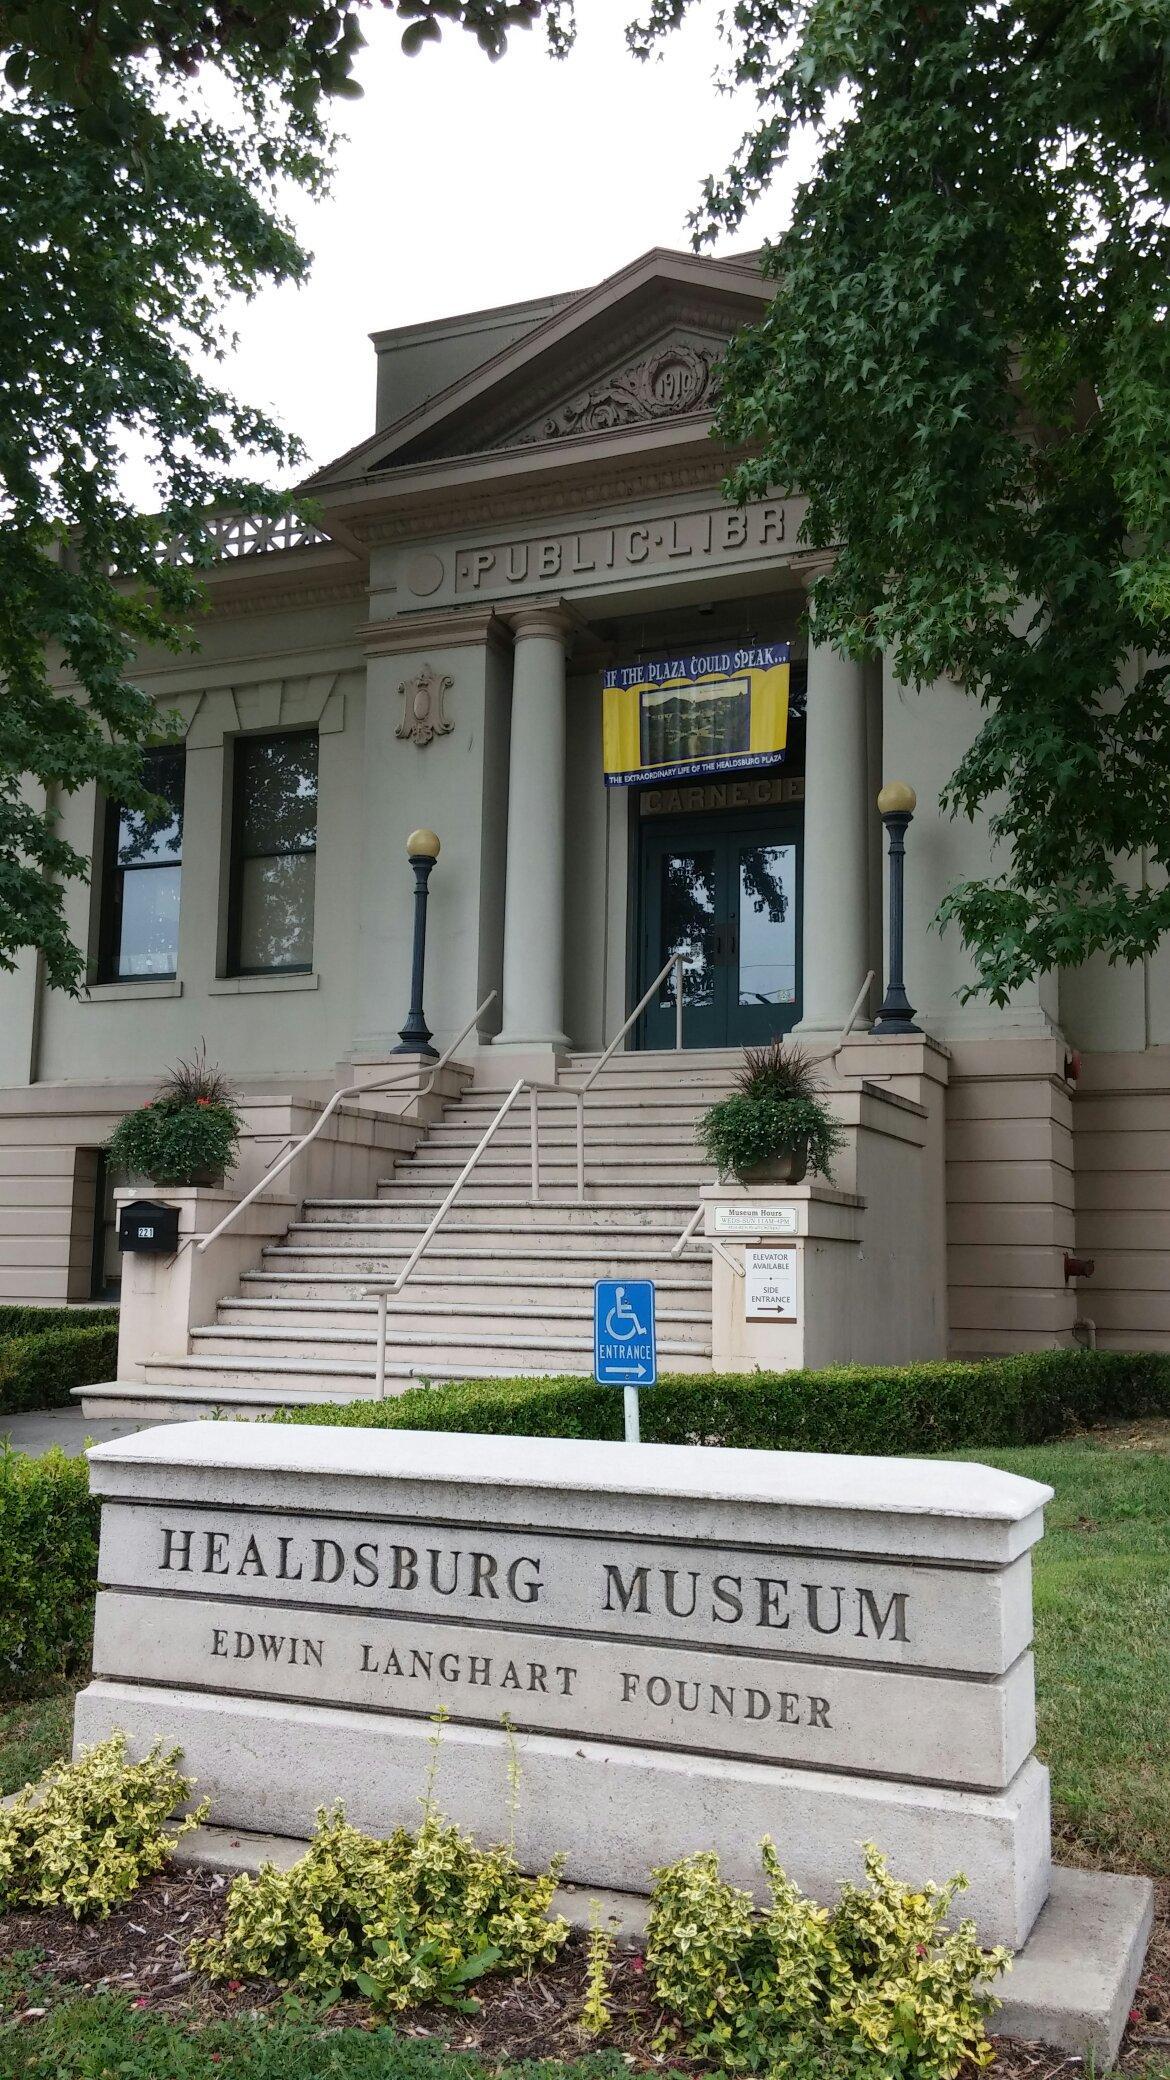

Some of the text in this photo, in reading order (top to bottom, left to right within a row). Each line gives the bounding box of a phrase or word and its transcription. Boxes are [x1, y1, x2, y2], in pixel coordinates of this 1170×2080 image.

[668, 504, 785, 558] LIBR
[606, 669, 618, 688] IF
[621, 666, 645, 686] THE
[648, 660, 686, 681] PLAZA
[690, 655, 731, 675] COULD
[608, 754, 783, 784] THE EXTRAORDINARY LIFE OF THE HEALDSBURG PLAZA
[648, 777, 804, 812] CARNEGIE
[728, 1209, 782, 1217] Museum Hours
[139, 1228, 153, 1237] 221
[752, 1253, 788, 1261] ELEVATOR
[752, 1262, 790, 1270] AVAILABLE
[763, 1286, 779, 1294] SIDE
[751, 1295, 791, 1303] ENTRANCE
[599, 1344, 652, 1360] ENTRANCE
[158, 1528, 912, 1643] HEALDSBURG MUSEUM
[210, 1629, 833, 1729] EDWIN LANGHART FOUNDER
